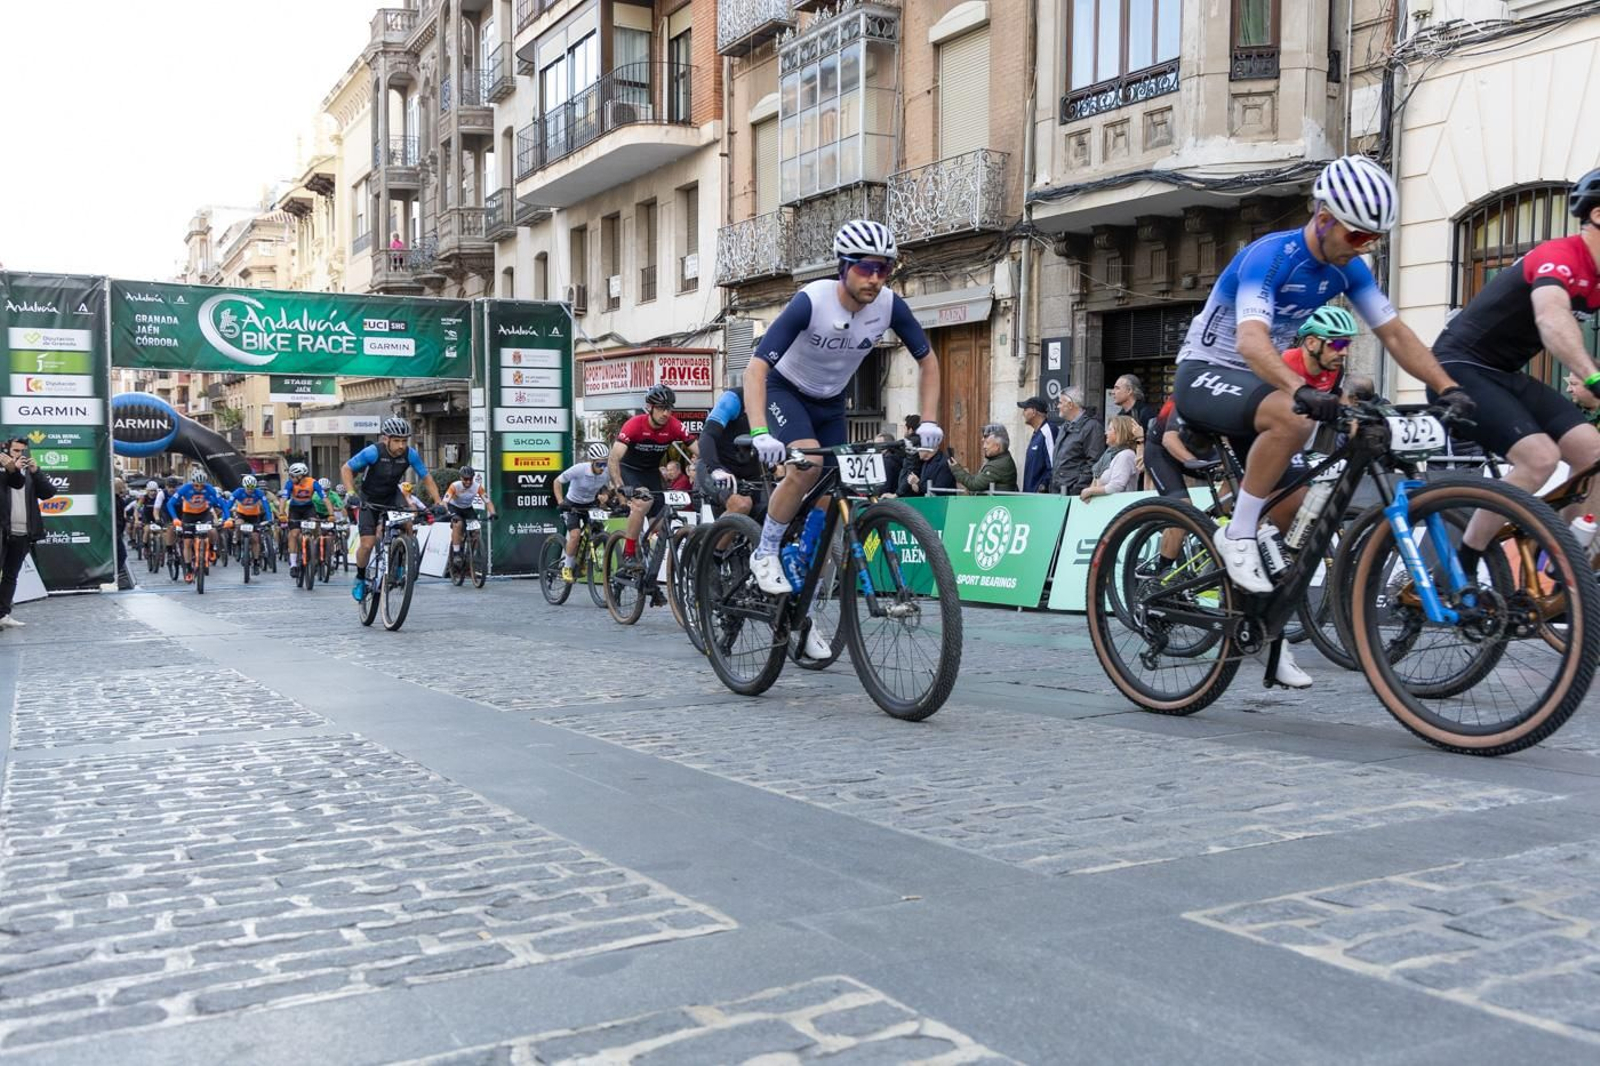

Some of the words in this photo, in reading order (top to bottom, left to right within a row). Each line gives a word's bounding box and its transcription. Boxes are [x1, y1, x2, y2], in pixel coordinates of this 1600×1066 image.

[5, 300, 60, 314] Andalucía
[135, 314, 179, 325] GRANADA
[241, 304, 356, 335] Andalucía
[135, 325, 160, 334] JAÉN
[368, 321, 387, 330] UCI
[499, 324, 538, 336] Andalucía
[135, 336, 179, 347] CÓRDOBA
[242, 332, 292, 352] BIKE
[298, 334, 357, 354] RACE
[369, 342, 410, 350] GARMIN
[659, 358, 710, 367] OPORTUNIDADES
[585, 362, 627, 381] OPORTUNIDADES
[661, 366, 710, 380] JAVIER
[586, 382, 600, 391] TODO
[602, 382, 609, 390] EN
[610, 380, 628, 388] TELAS
[18, 406, 87, 416] GARMIN
[114, 418, 168, 429] ARMIN
[506, 415, 557, 424] GARMIN
[514, 456, 550, 467] PIRELLI
[847, 456, 876, 478] 32-1
[517, 495, 548, 506] GOBIK
[669, 493, 686, 502] 43-1
[902, 547, 926, 564] JAÉN
[956, 574, 980, 586] SPORT
[980, 575, 1017, 588] BEARINGS
